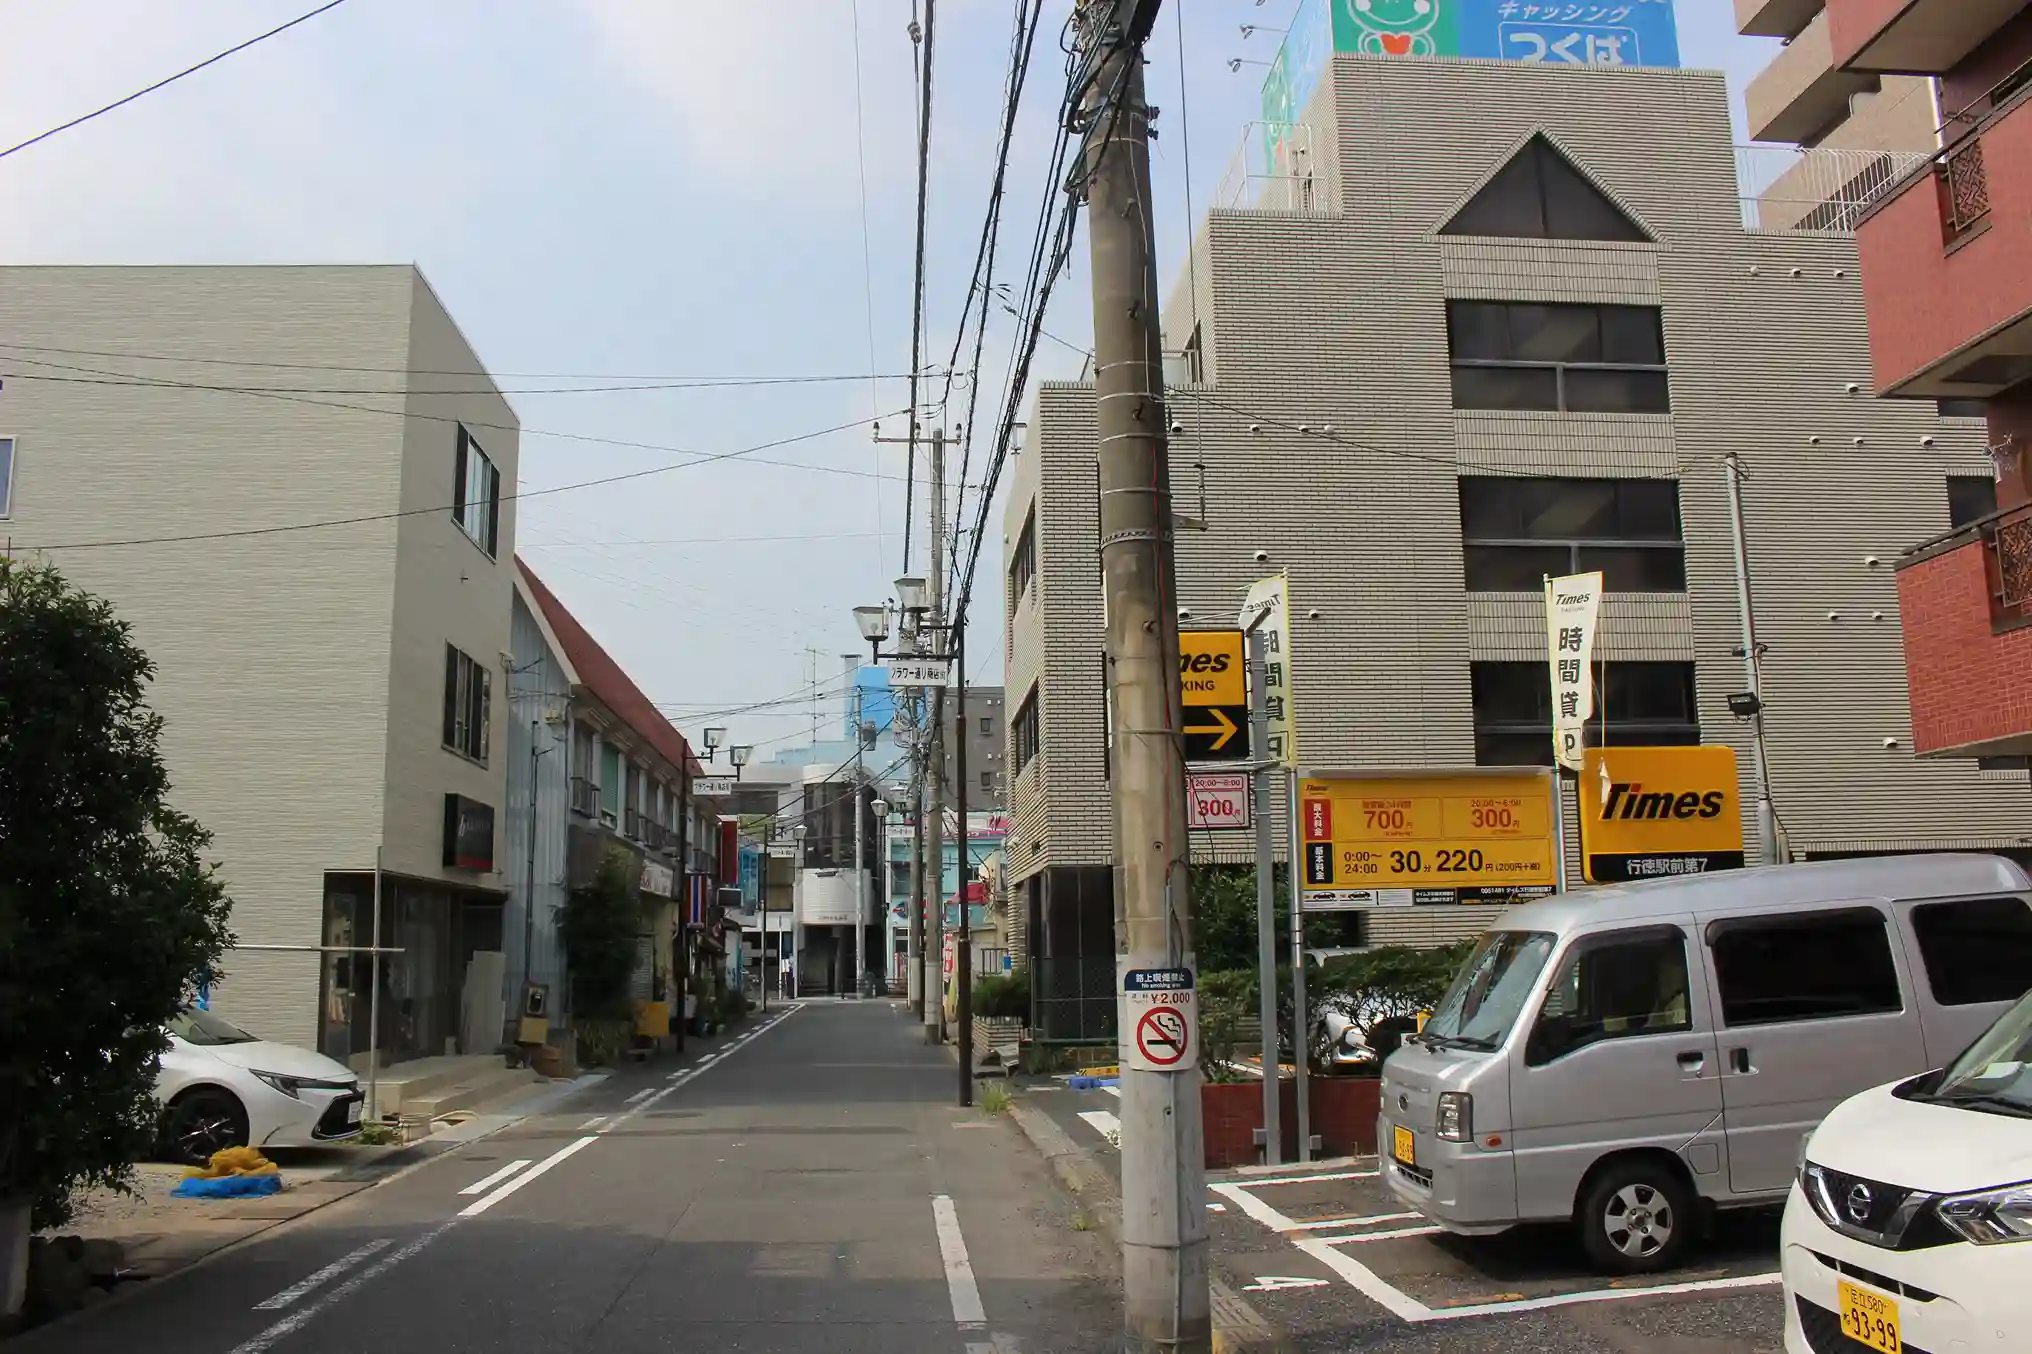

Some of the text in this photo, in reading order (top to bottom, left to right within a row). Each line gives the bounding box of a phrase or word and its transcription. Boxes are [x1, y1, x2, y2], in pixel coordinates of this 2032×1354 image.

[1498, 2, 1634, 23] キャッシング
[1510, 32, 1629, 65] つくば
[1556, 591, 1591, 606] Times
[1558, 626, 1583, 750] 時間貸P
[1602, 782, 1724, 821] Times
[1344, 863, 1378, 874] 24:00
[1626, 856, 1708, 875] 行徳駅前第7
